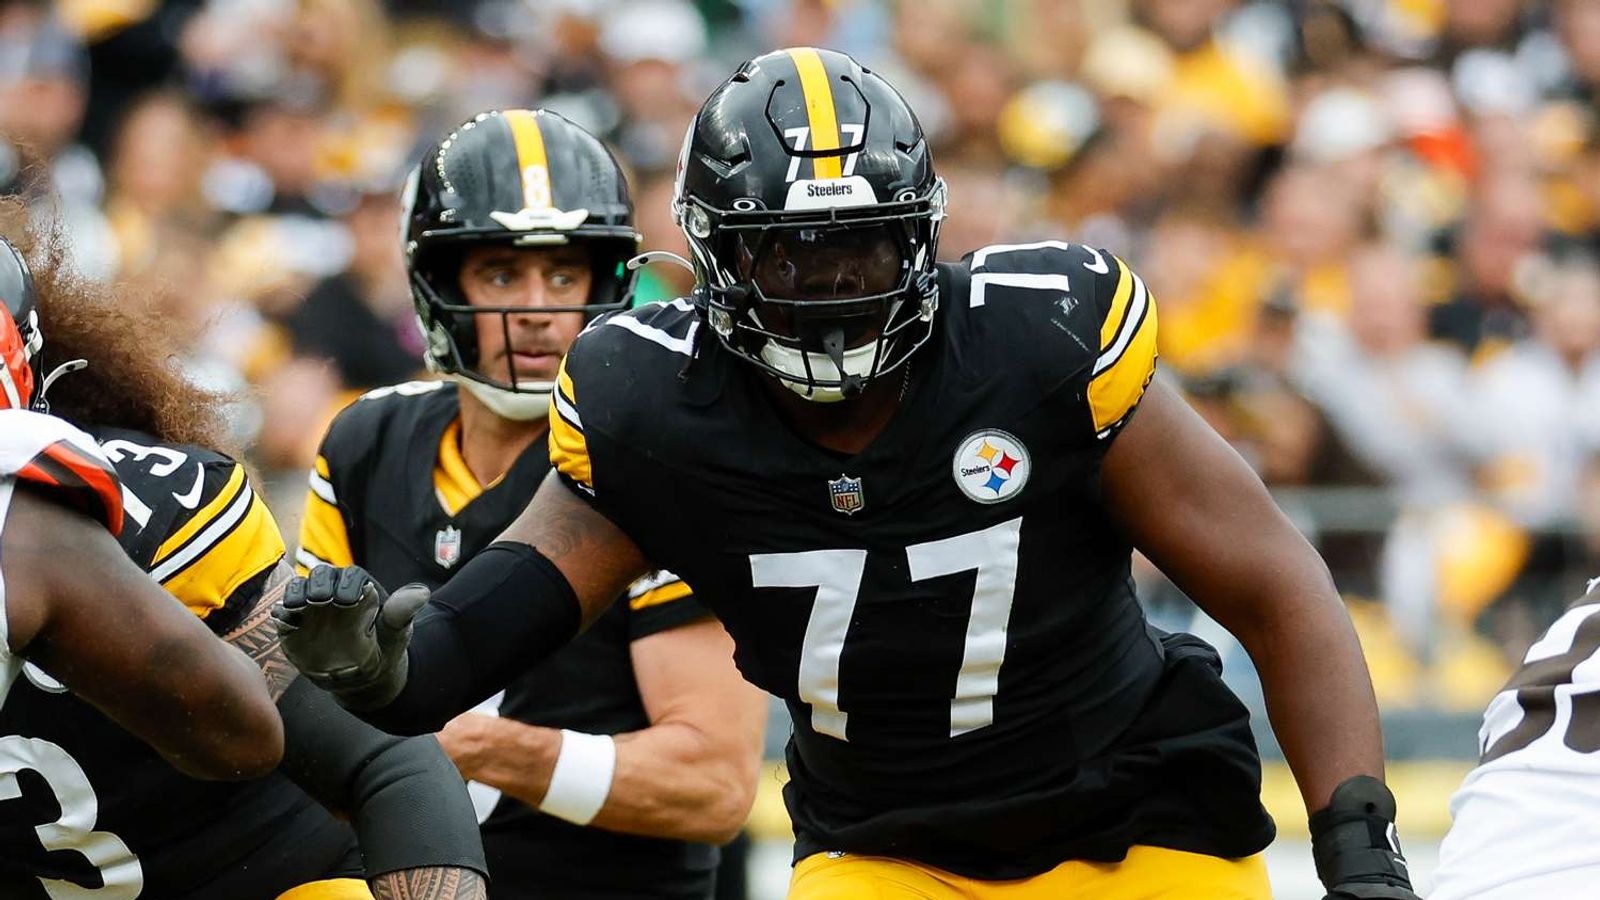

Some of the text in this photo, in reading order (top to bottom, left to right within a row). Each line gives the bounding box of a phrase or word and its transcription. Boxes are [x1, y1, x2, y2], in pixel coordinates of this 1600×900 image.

[784, 124, 865, 183] 77
[807, 183, 853, 197] Steelers
[961, 465, 990, 477] Steelers
[749, 516, 1023, 742] 77
